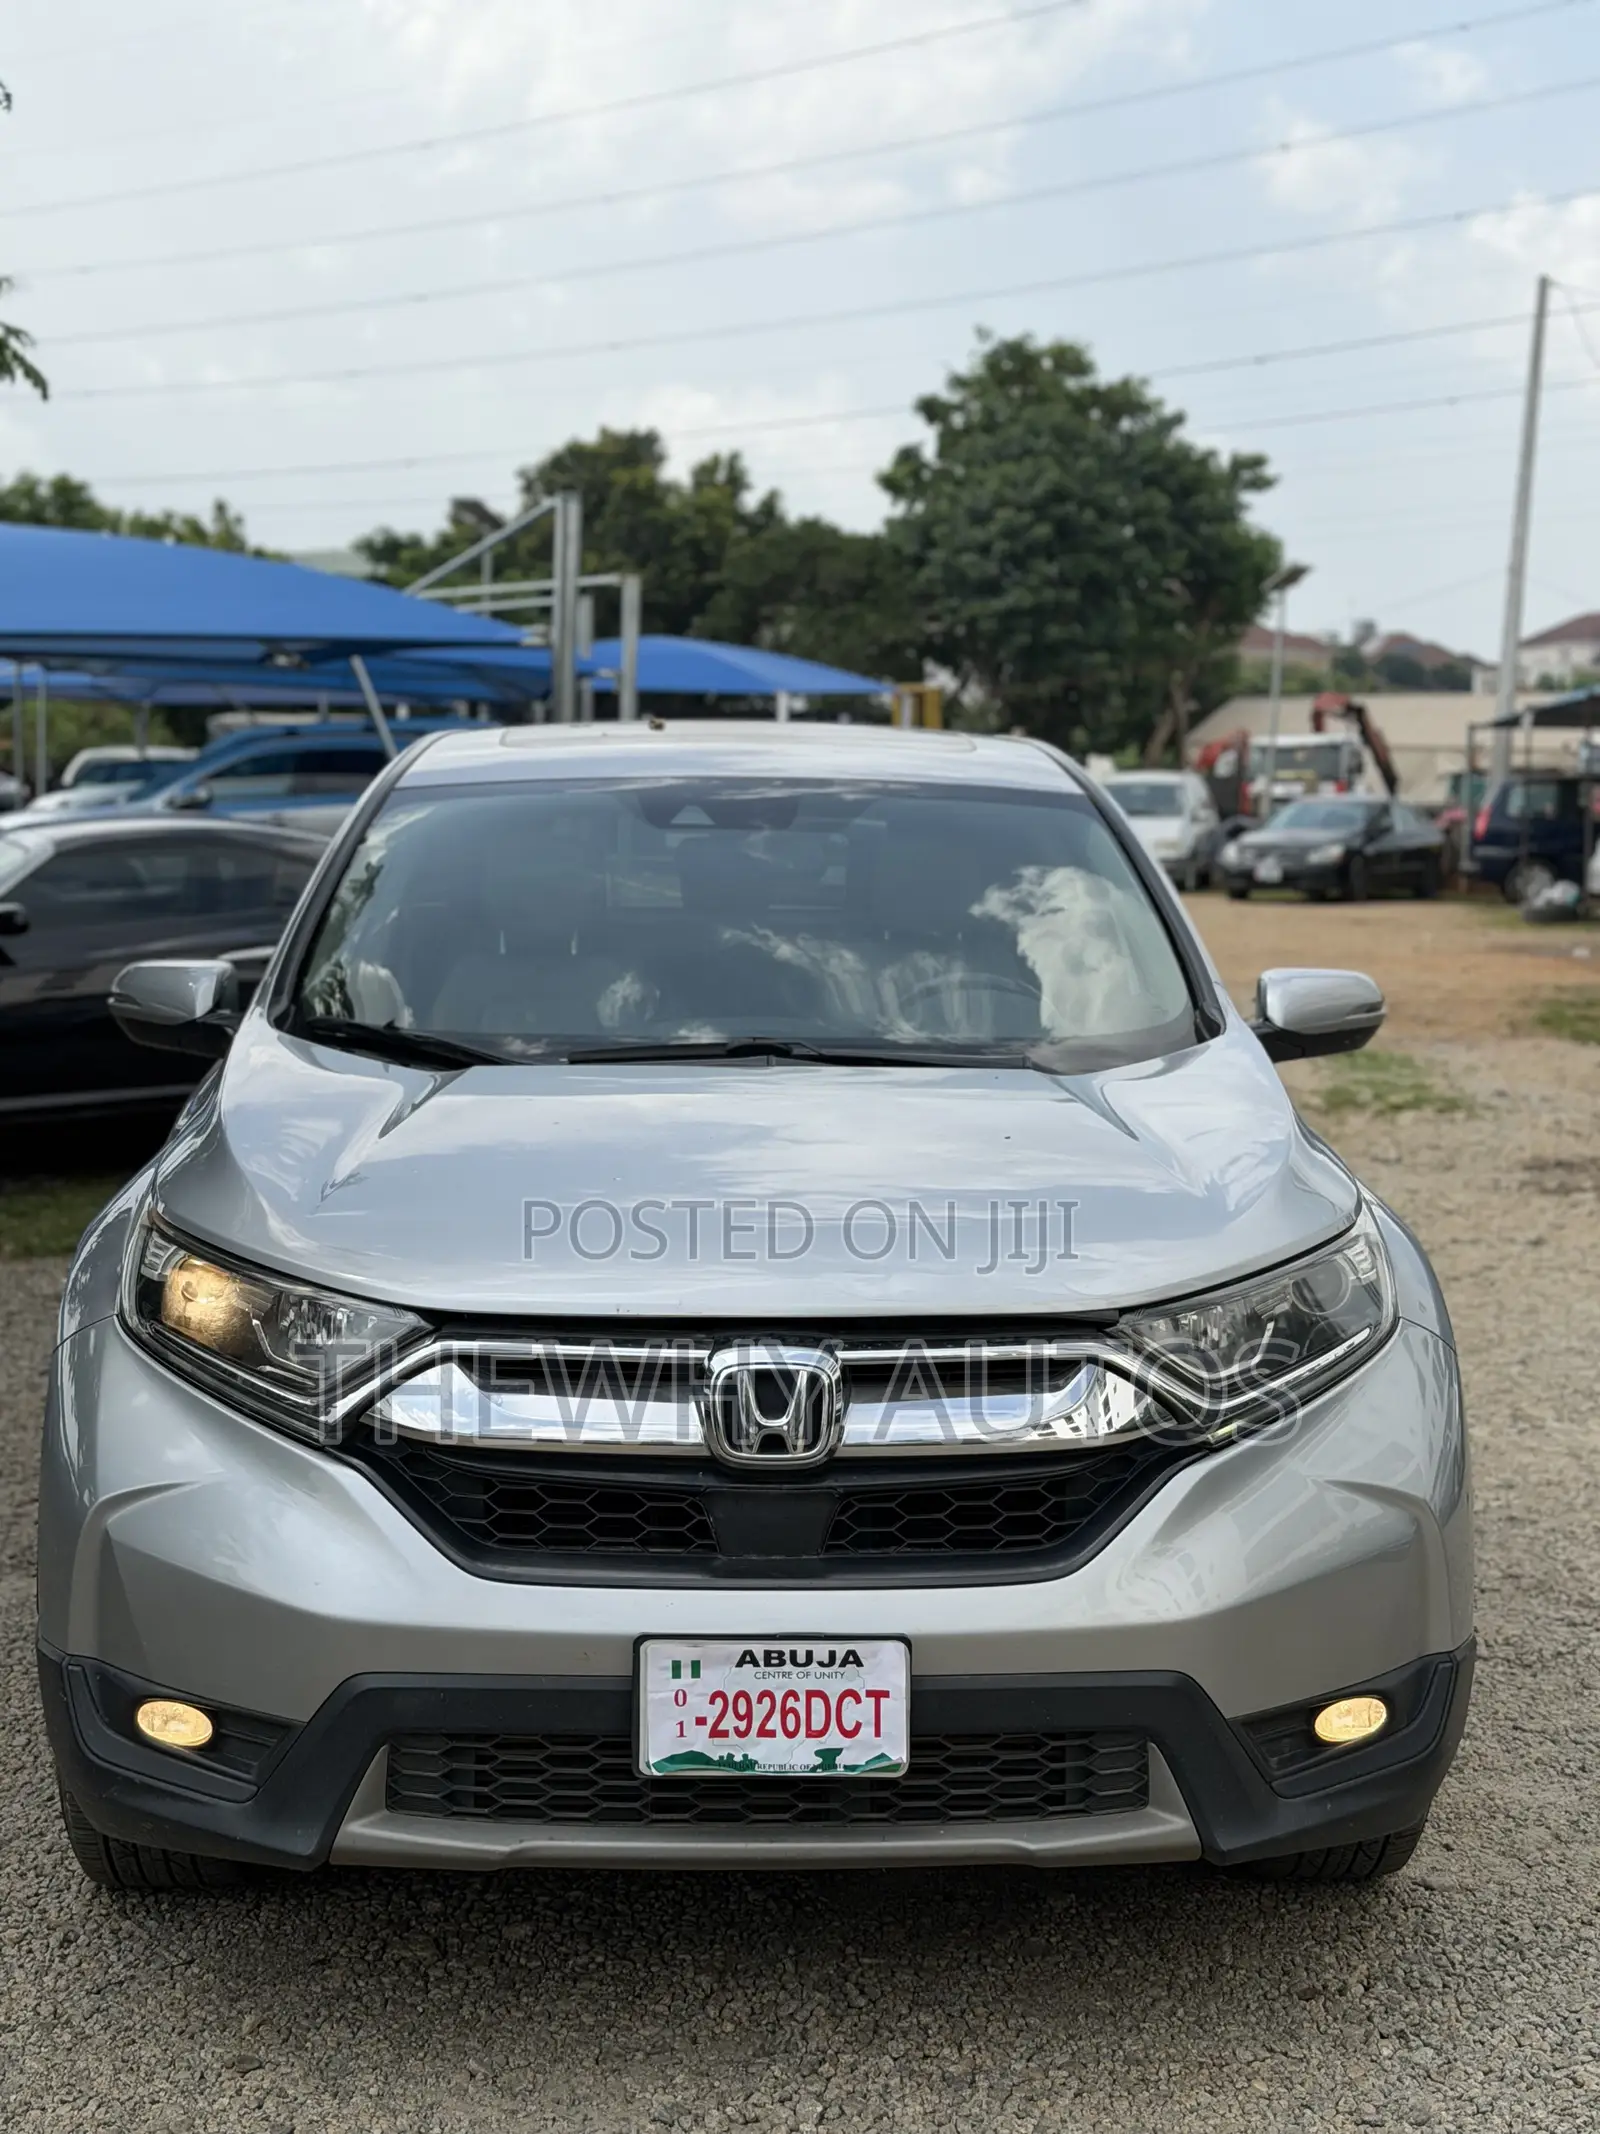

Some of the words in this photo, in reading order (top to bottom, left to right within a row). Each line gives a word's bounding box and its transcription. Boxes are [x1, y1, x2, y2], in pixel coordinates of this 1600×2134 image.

[734, 1649, 864, 1668] ABUJA
[753, 1670, 793, 1680] CENTRE
[796, 1670, 812, 1680] OF
[814, 1670, 846, 1680] UNITY
